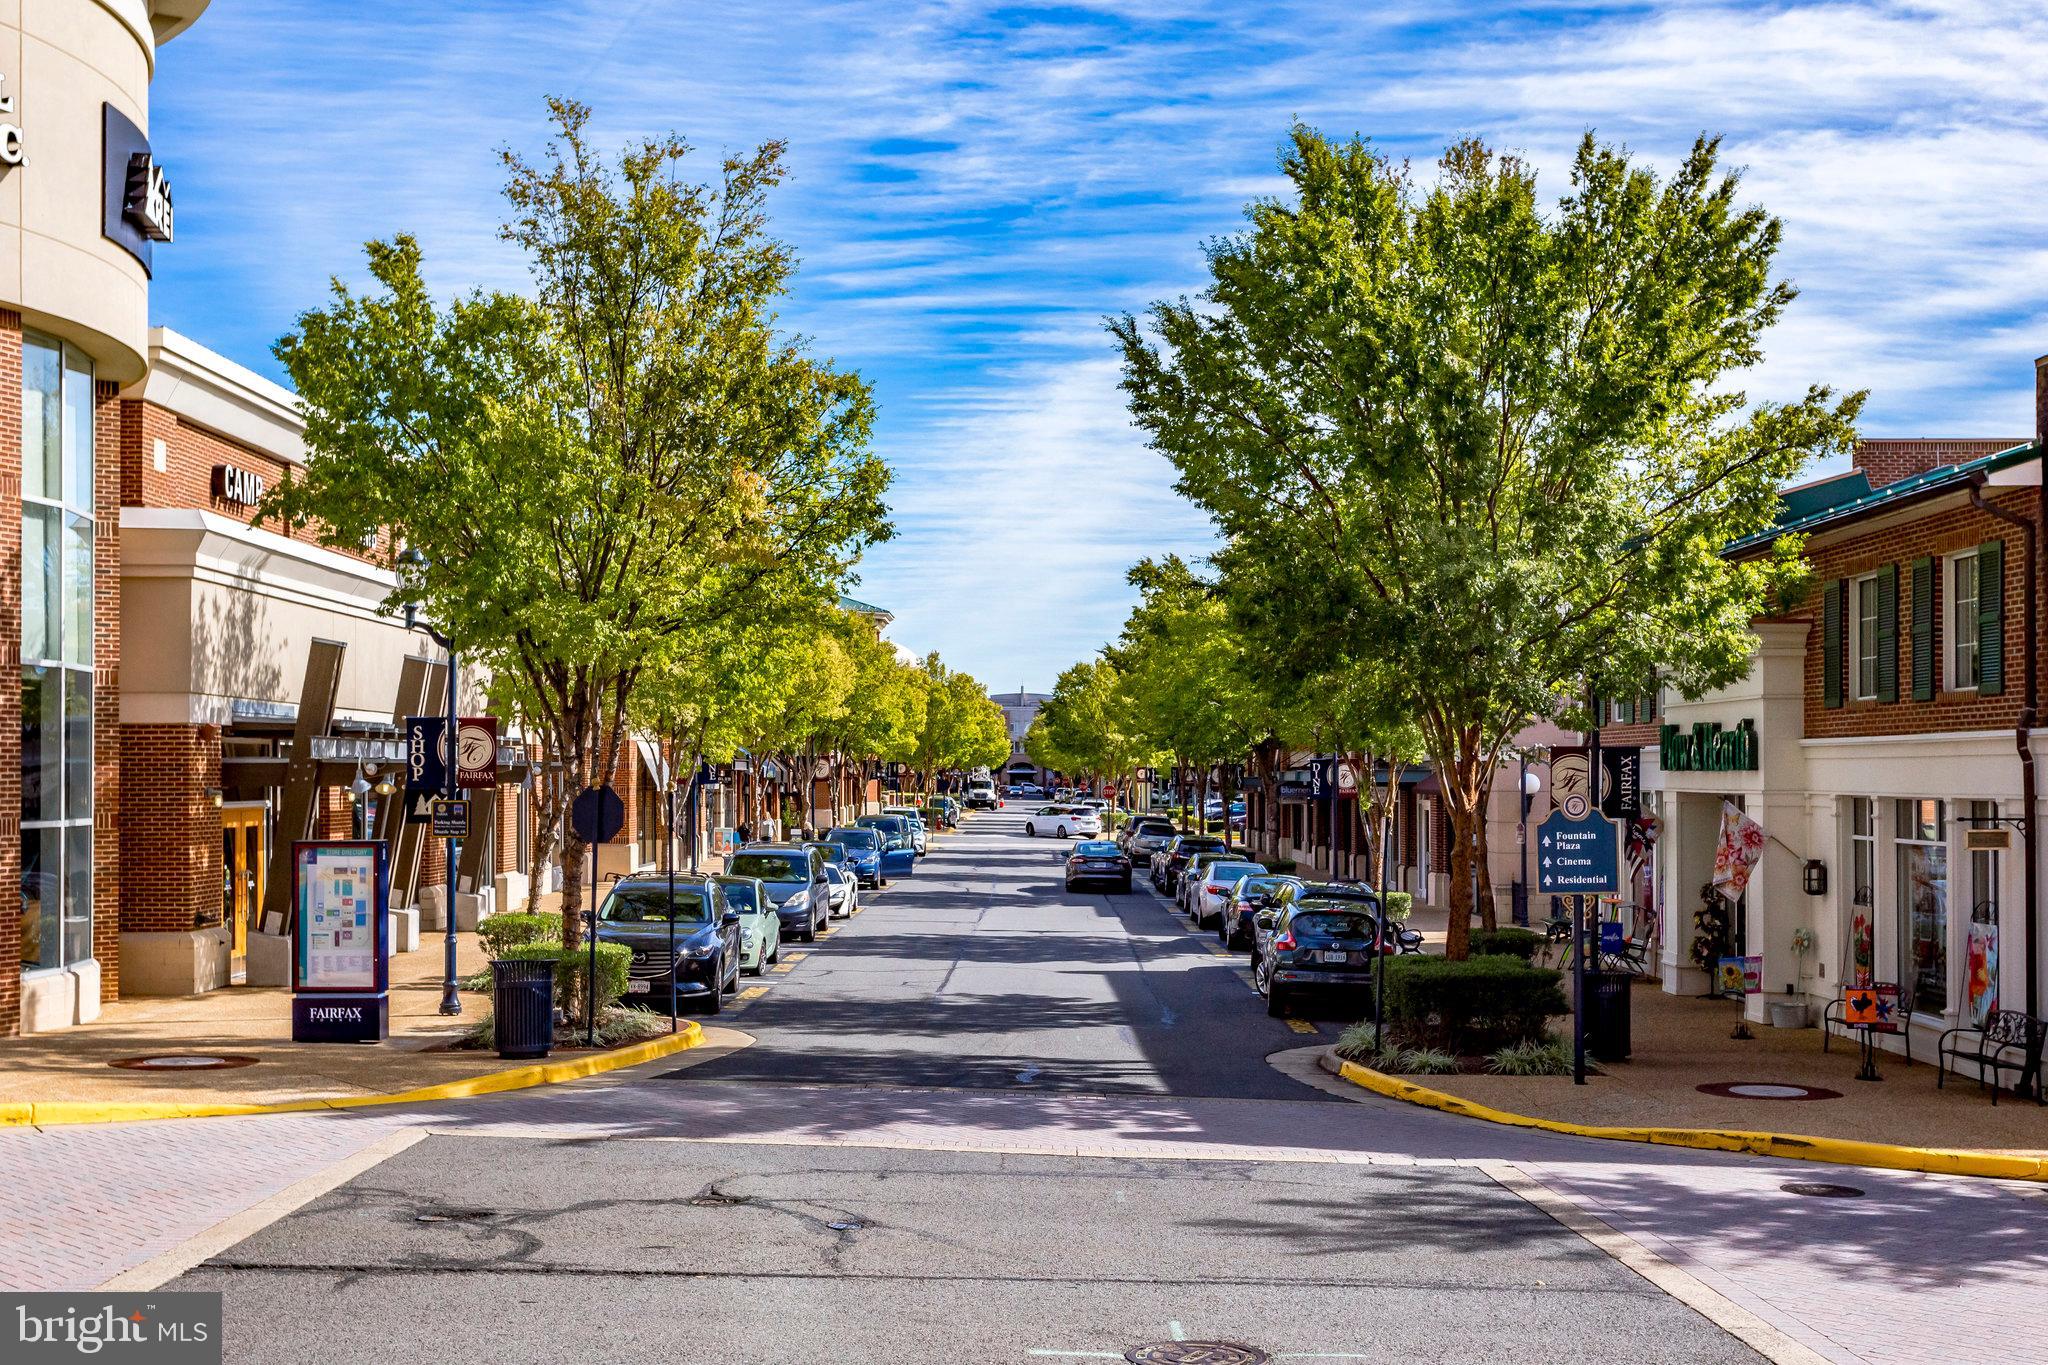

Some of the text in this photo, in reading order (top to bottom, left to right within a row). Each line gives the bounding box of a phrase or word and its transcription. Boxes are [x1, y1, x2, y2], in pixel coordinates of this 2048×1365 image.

[410, 725, 426, 782] SHOP
[460, 771, 494, 779] FAIRFAX
[1312, 762, 1320, 795] DINE
[1620, 755, 1632, 811] FAIRFAX
[1556, 831, 1597, 840] Fountain
[1556, 841, 1581, 850] Plaza
[1556, 856, 1592, 866] Cinema
[1557, 875, 1607, 884] Residential
[309, 1007, 362, 1019] FAIRFAX
